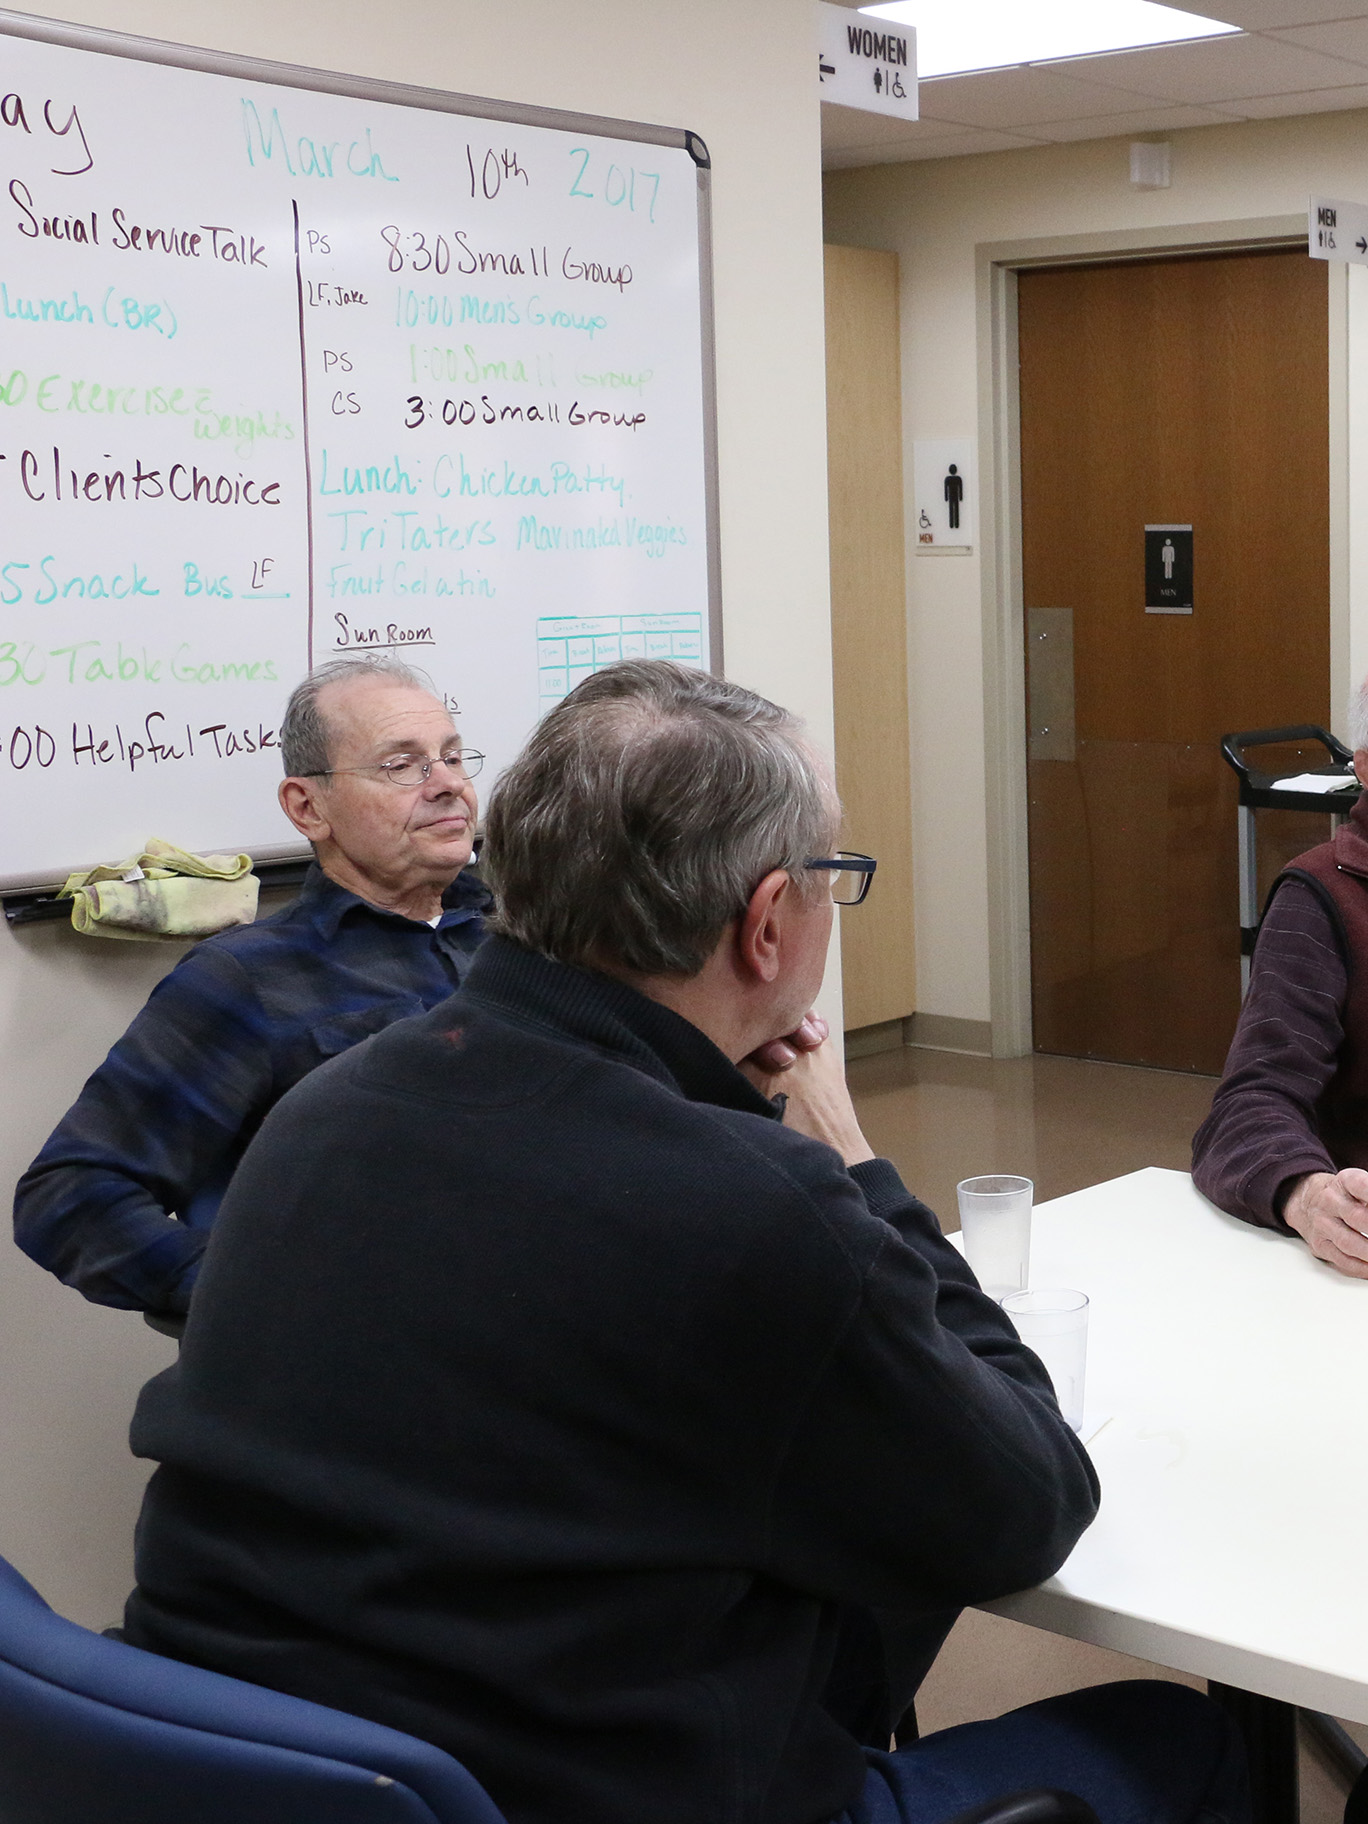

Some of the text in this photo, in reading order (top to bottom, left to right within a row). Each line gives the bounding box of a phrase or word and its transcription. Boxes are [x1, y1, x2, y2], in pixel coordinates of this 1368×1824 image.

[847, 25, 907, 66] WOMEN
[240, 97, 660, 224] March 10th 2017
[8, 178, 268, 268] Social Service Talk
[1318, 207, 1336, 227] MEN
[307, 229, 332, 254] PS
[381, 225, 633, 293] 8:30 Small Group
[102, 286, 177, 340] (BR)
[396, 286, 608, 339] 10:00 Men's Group
[323, 349, 354, 373] PS
[409, 343, 654, 396] 1:00 Small Group
[37, 374, 190, 414] Exercise
[332, 391, 361, 415] CS
[404, 395, 646, 432] 3:00 Small Group
[21, 446, 281, 505] Clients Choice
[319, 448, 421, 496] Lunch:
[434, 453, 550, 499] Chicken
[327, 510, 388, 552] Tri
[391, 511, 496, 552] Taters
[626, 514, 688, 558] Veggies
[919, 533, 933, 543] MEN
[34, 555, 160, 605] Snack
[184, 562, 234, 598] Bus
[251, 558, 274, 589] LF
[326, 561, 496, 598] Fruit Gelatin
[1160, 588, 1176, 597] MEN
[335, 612, 435, 646] Sun Room
[49, 640, 160, 684] Table
[170, 642, 278, 683] Games
[73, 711, 194, 772] Helpful
